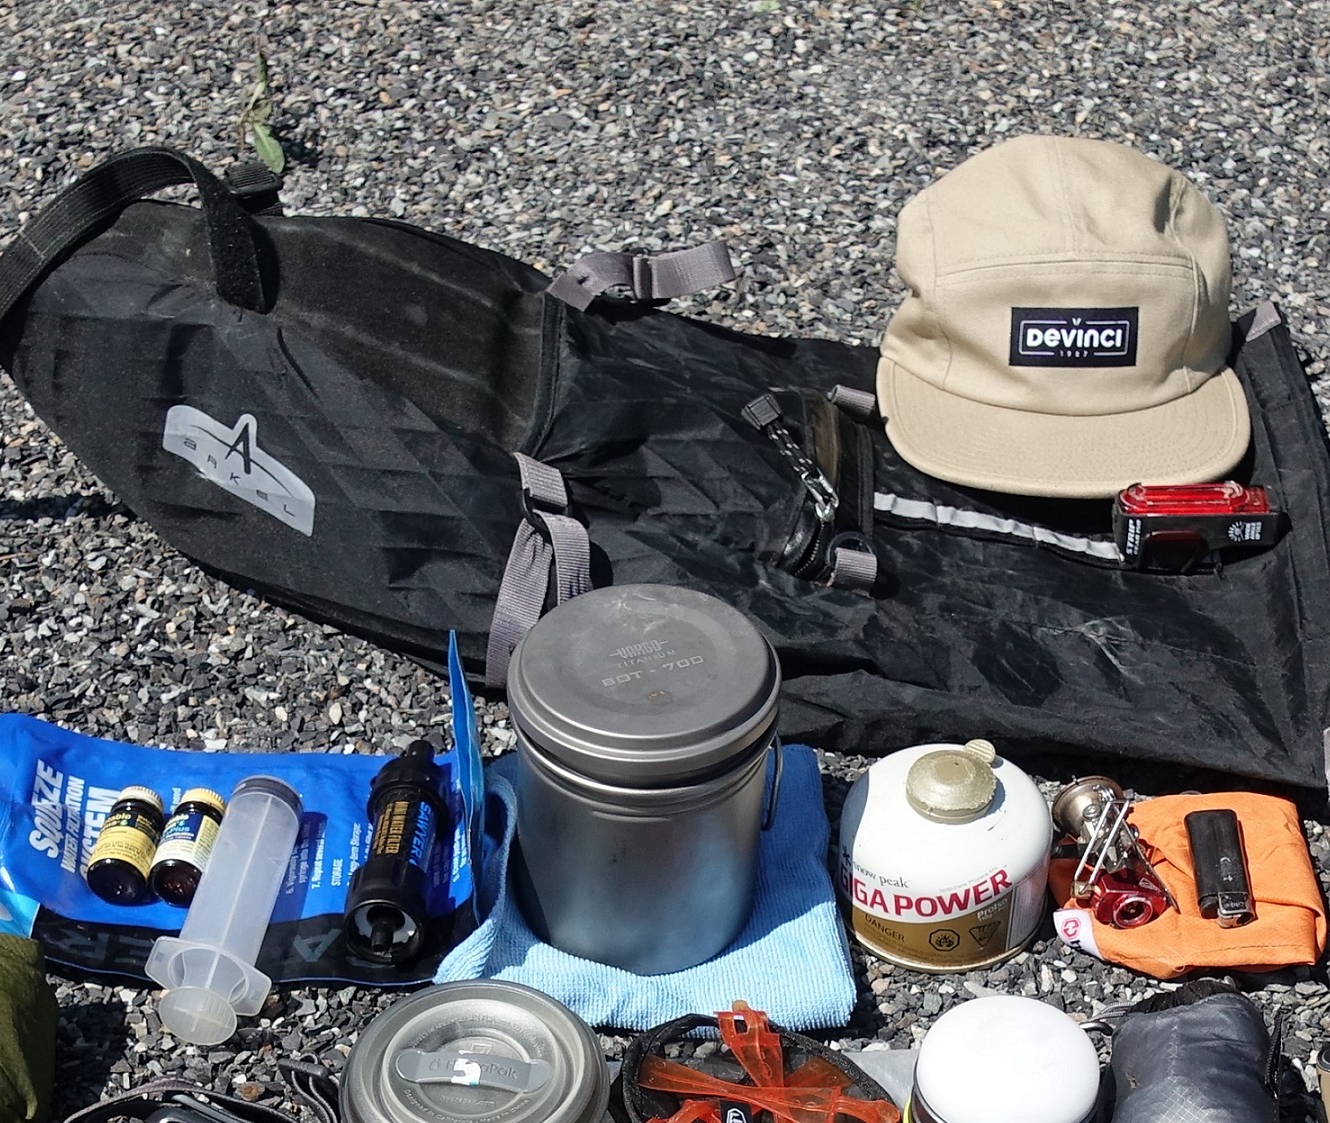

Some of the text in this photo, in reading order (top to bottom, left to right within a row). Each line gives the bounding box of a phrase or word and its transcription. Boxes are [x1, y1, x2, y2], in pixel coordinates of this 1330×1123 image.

[1126, 519, 1134, 556] STRIP
[617, 640, 662, 659] VARGO
[601, 670, 642, 687] BOT
[663, 655, 704, 671] 700
[409, 801, 432, 862] SAWYER
[330, 858, 343, 886] STORAGE
[879, 875, 909, 889] peak
[840, 866, 1013, 918] GIGA POWER
[864, 914, 906, 944] DANGER
[446, 1059, 518, 1081] HaPak
